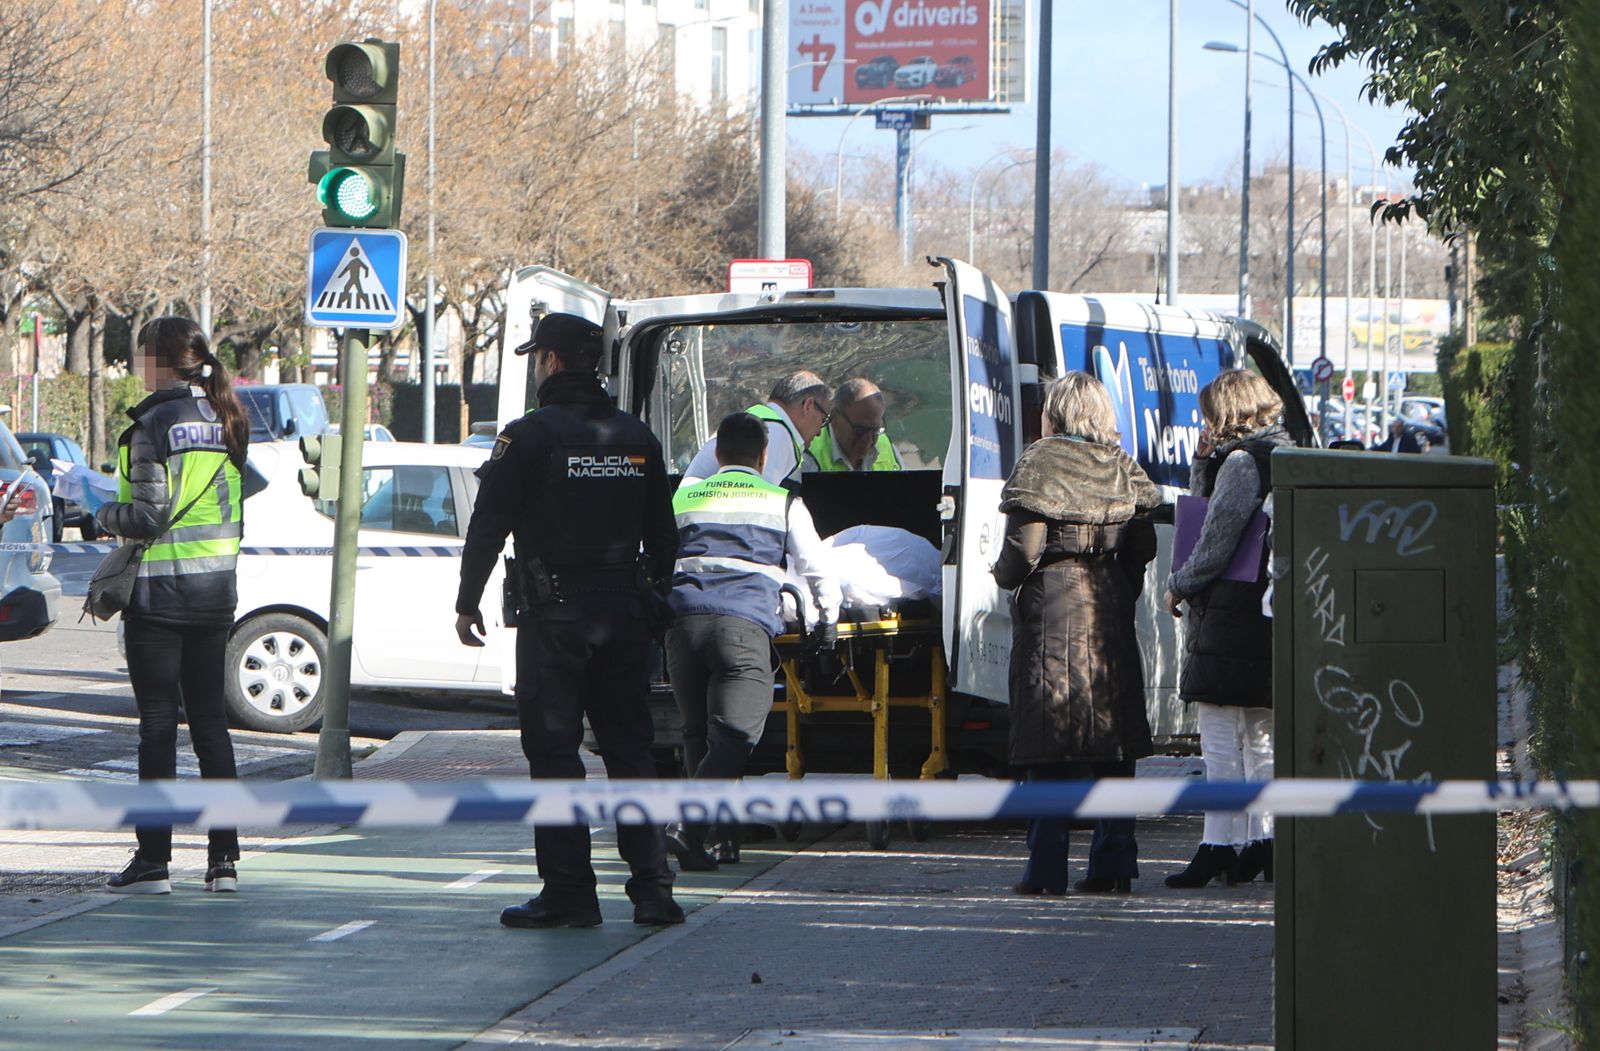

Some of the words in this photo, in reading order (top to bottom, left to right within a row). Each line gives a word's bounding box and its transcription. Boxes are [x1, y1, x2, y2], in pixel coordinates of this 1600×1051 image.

[893, 0, 979, 28] driveris
[970, 377, 1012, 425] ervión
[171, 425, 225, 447] POLIC
[567, 455, 632, 467] POLICIA
[567, 466, 645, 478] NACIONAL
[705, 480, 755, 489] FUNERARIA
[687, 490, 729, 499] COMISION
[730, 491, 769, 499] JUDICIAL
[571, 795, 654, 823] NO
[677, 793, 851, 823] PASAR
